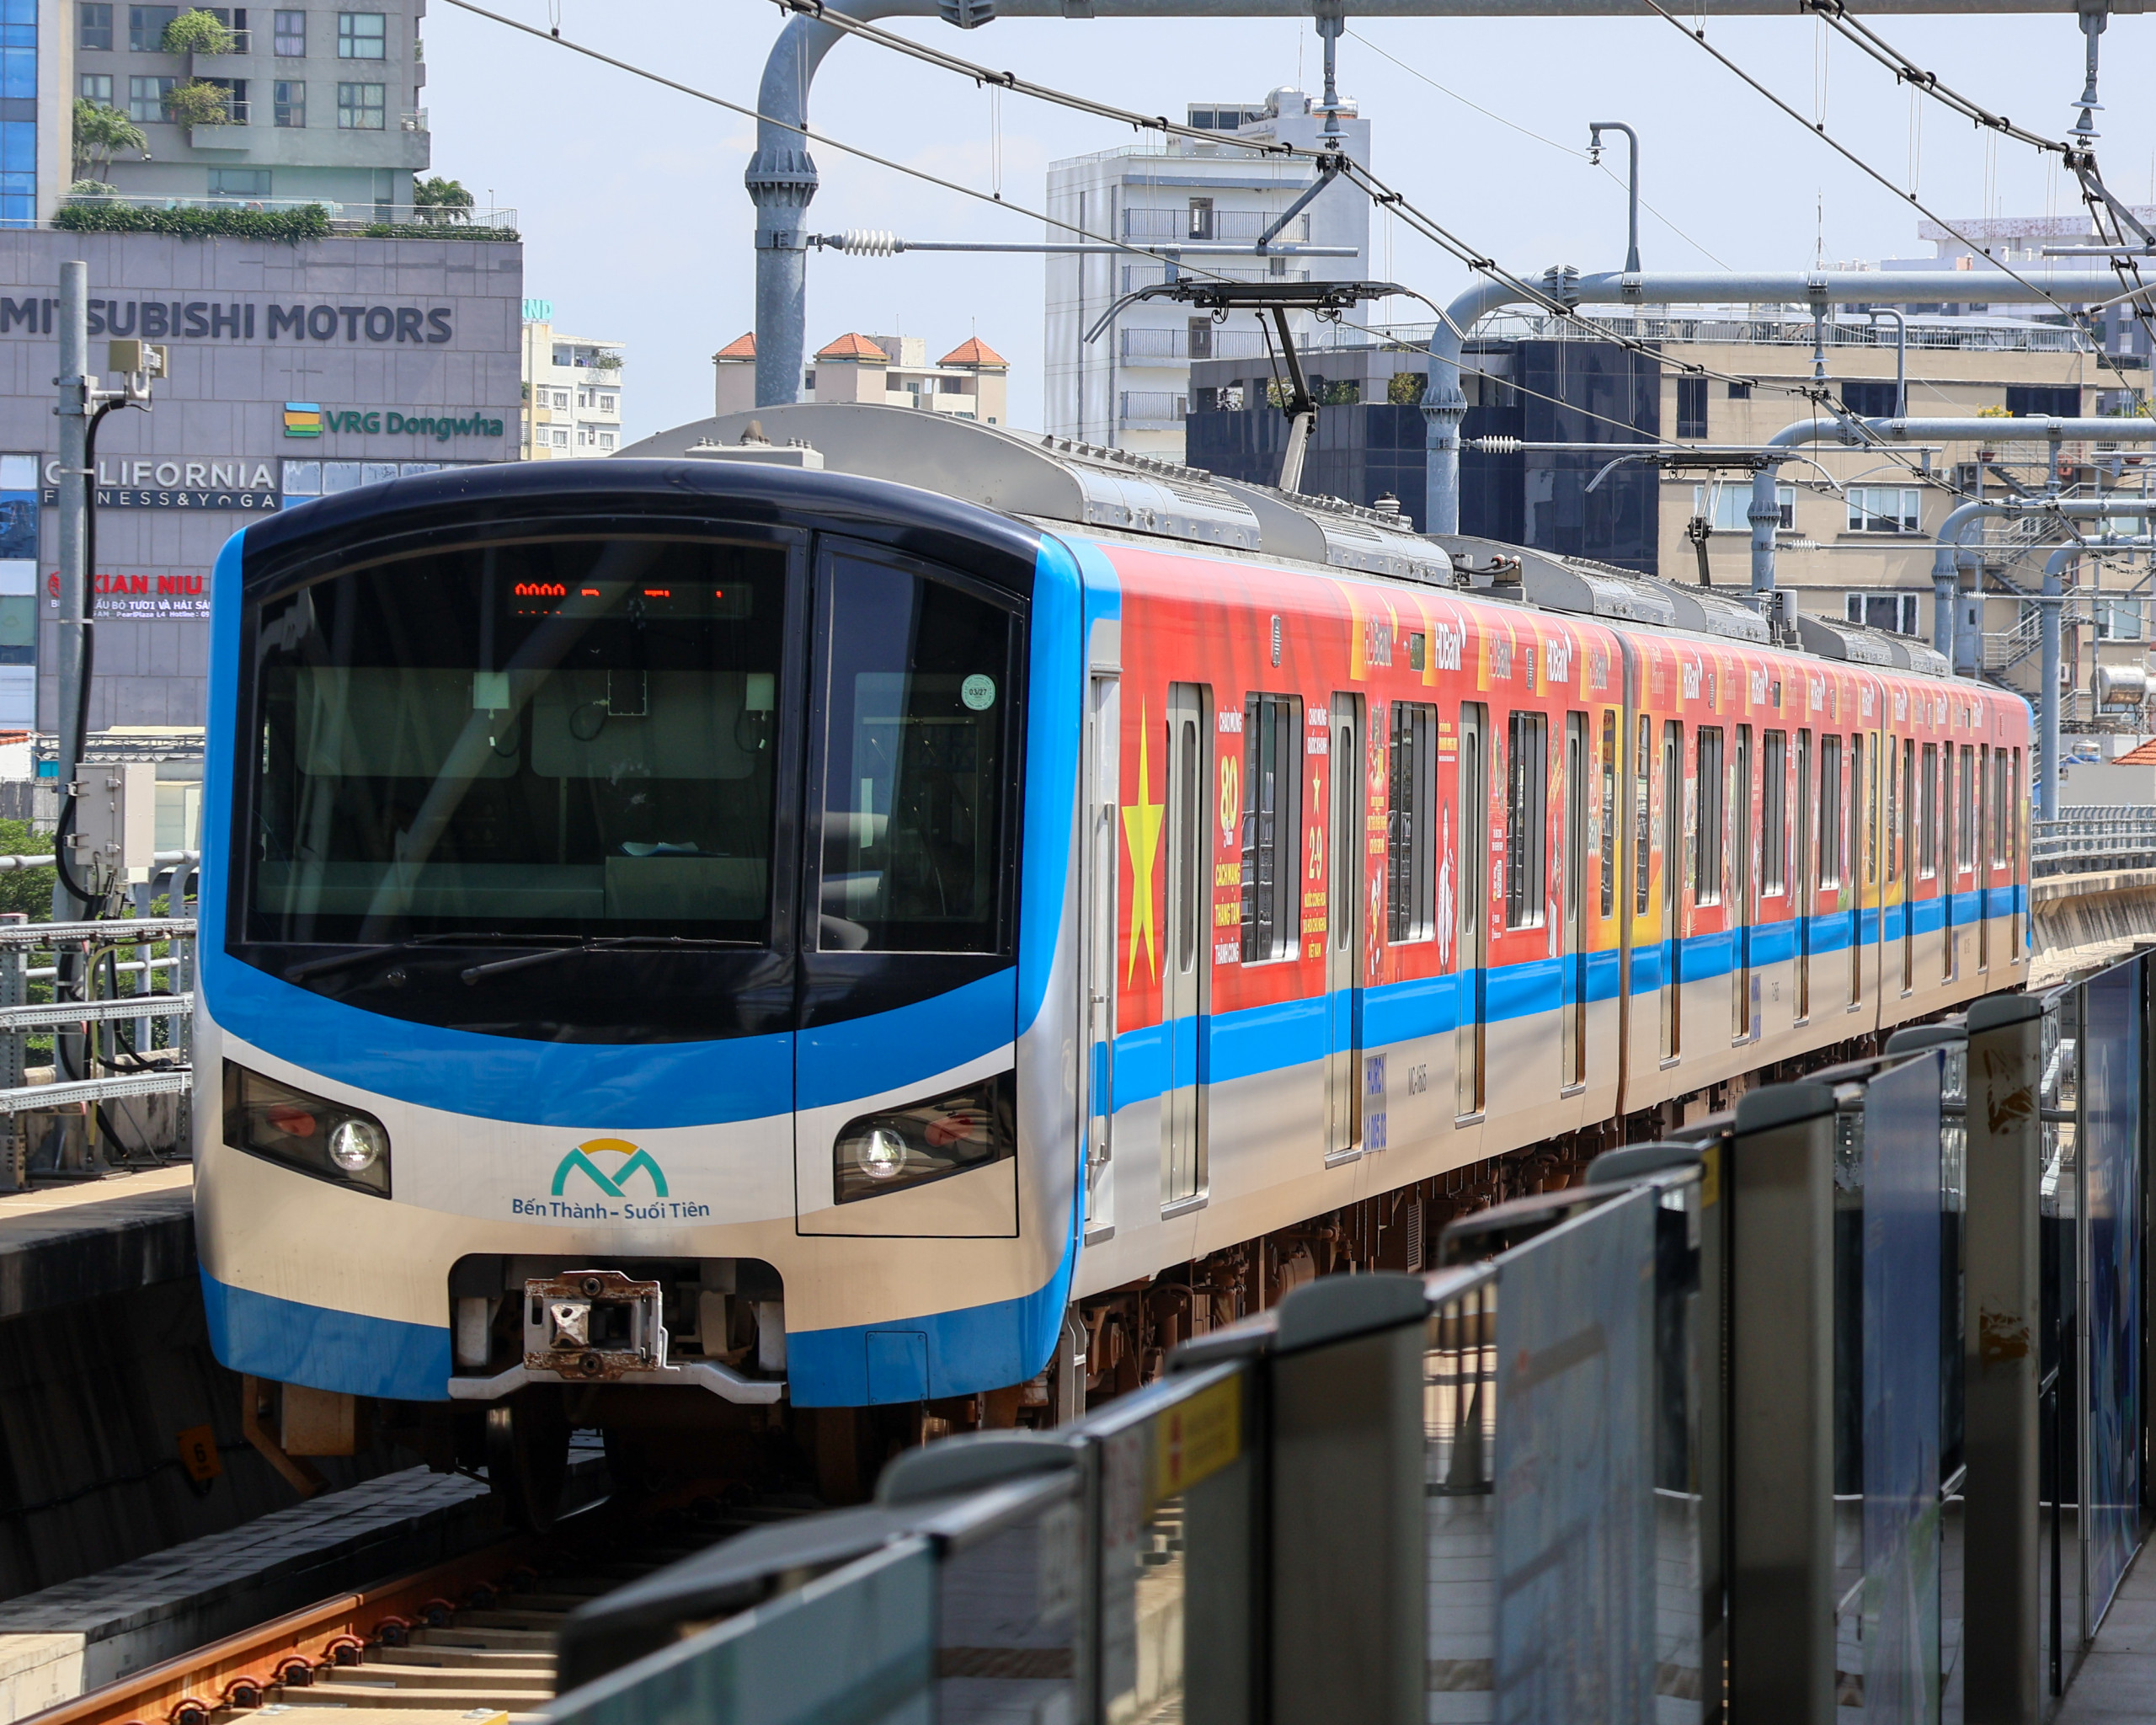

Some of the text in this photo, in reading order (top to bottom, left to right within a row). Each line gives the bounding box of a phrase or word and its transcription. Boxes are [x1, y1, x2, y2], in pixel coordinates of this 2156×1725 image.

[0, 296, 453, 343] MISUBISHI MOTORS
[327, 410, 504, 441] VRG Dongwha
[45, 460, 275, 489] CLIFORNIA
[157, 574, 203, 595] NIU
[157, 599, 171, 610] VÀ
[1434, 622, 1462, 671] HDBank
[1546, 638, 1569, 683] HDBank
[1683, 662, 1700, 699] HDBank
[1220, 755, 1239, 830] 80
[1309, 825, 1323, 880] 2-9
[512, 1199, 547, 1216] Bến
[549, 1201, 607, 1220] Thành
[624, 1202, 665, 1220] Suối
[669, 1203, 710, 1219] Tiên
[193, 1442, 207, 1464] 6
